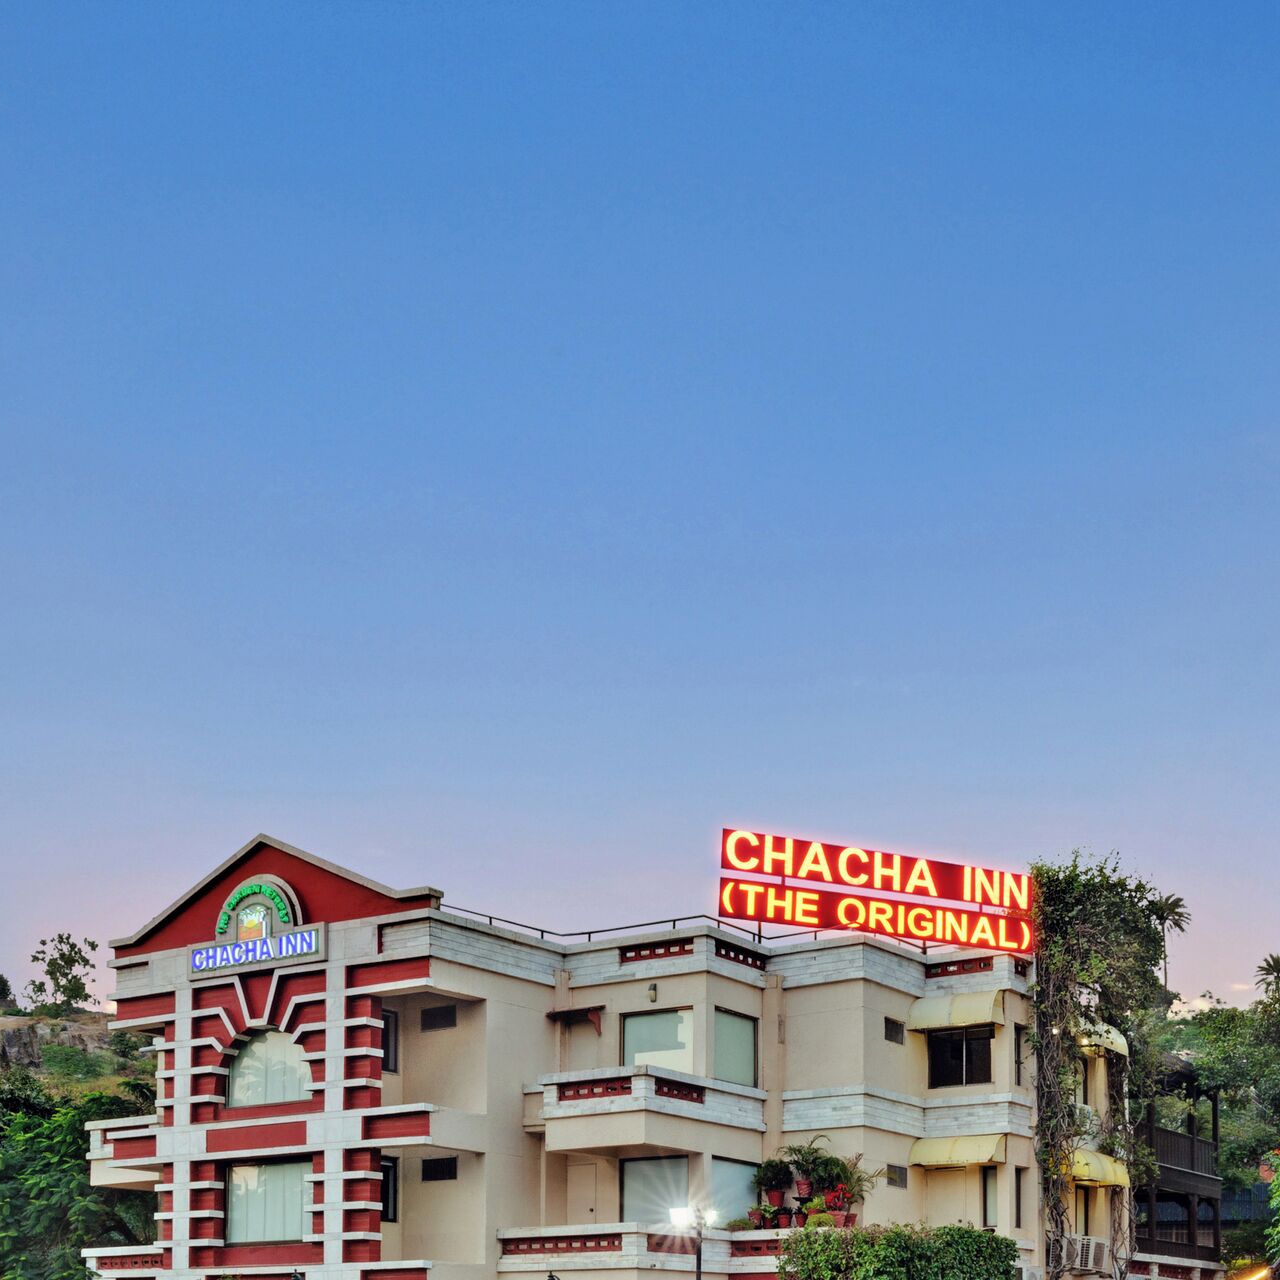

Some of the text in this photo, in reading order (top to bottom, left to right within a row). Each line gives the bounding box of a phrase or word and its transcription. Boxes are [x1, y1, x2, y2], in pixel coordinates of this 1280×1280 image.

[226, 883, 262, 911] GARDEN
[725, 830, 1029, 910] CHACHA INN
[722, 881, 1031, 950] (THE ORIGINAL)
[192, 930, 316, 971] CHACHA INN
